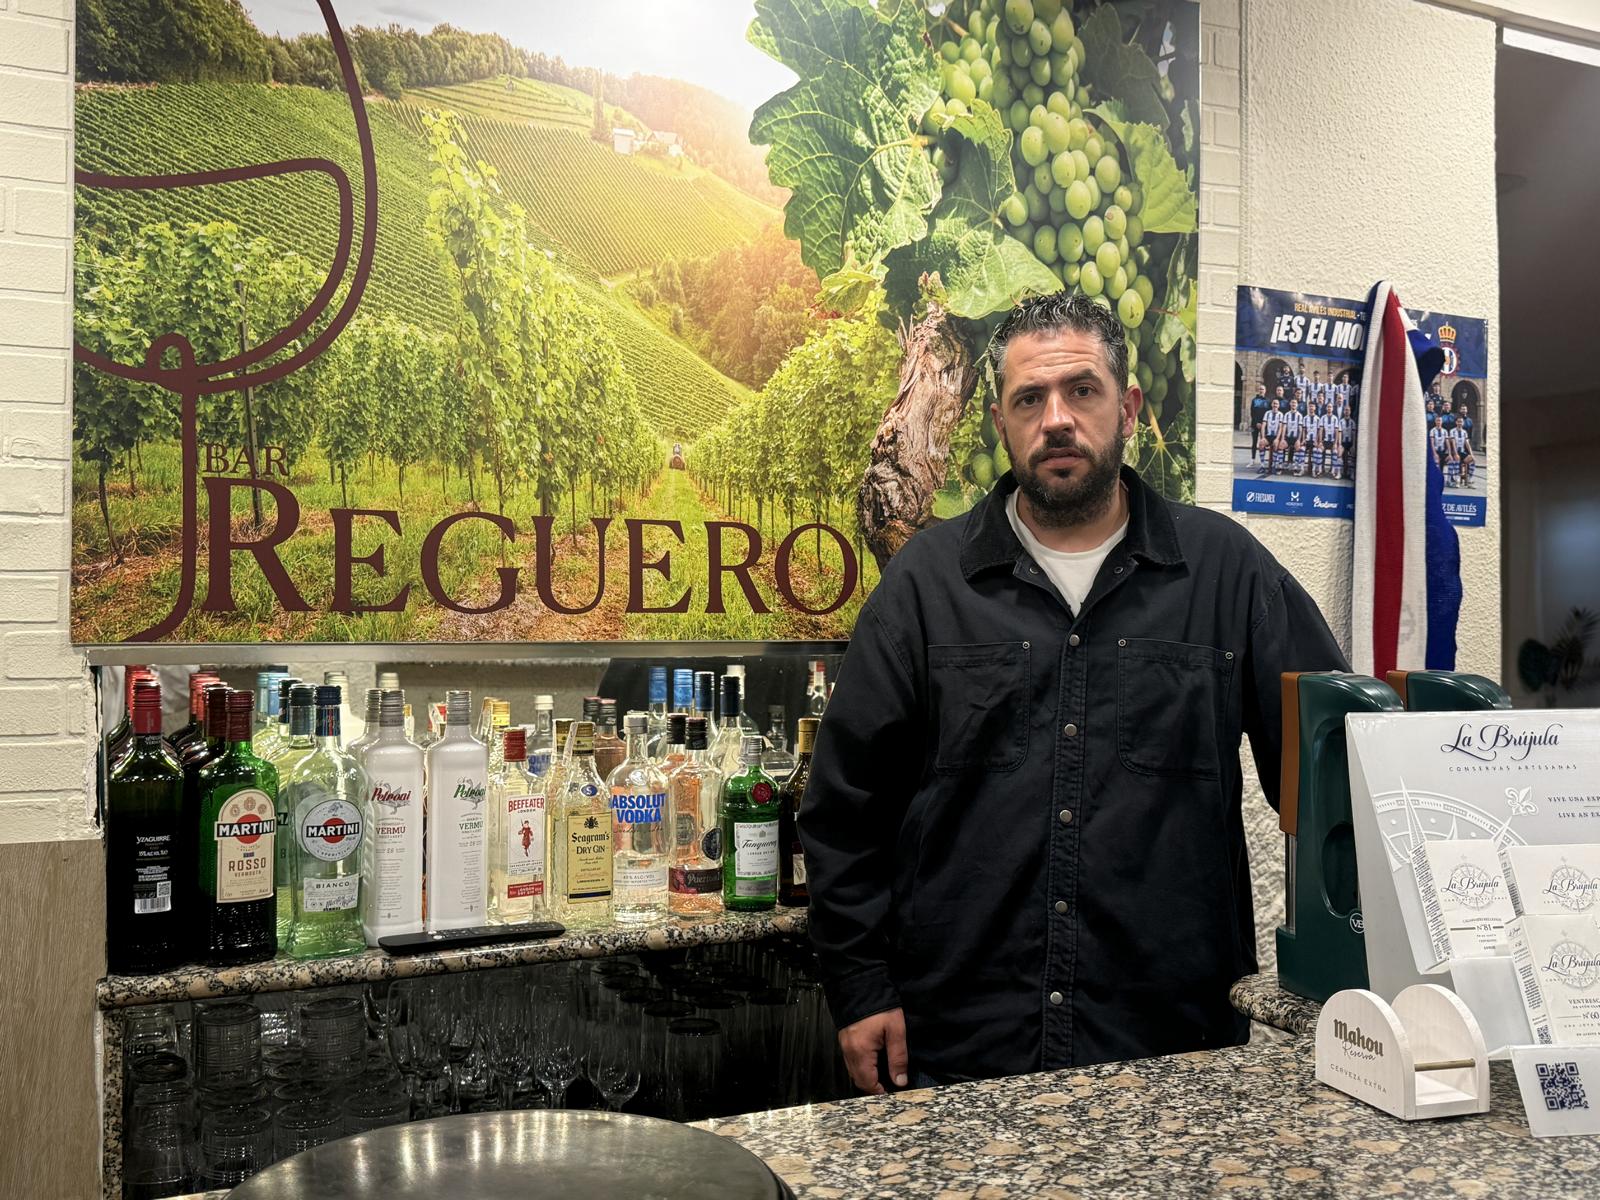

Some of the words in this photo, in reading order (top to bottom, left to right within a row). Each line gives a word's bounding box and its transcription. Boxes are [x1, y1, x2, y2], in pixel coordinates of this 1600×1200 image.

[1327, 307, 1357, 320] INDUSTRIAL
[1270, 314, 1306, 344] ¡ES
[1305, 318, 1329, 346] EL
[1330, 320, 1366, 350] MO
[204, 442, 288, 476] BAR
[202, 476, 859, 617] REGUERO
[1441, 723, 1497, 761] La
[1477, 723, 1564, 761] Brújula
[508, 797, 545, 813] BEEFEATER
[611, 793, 666, 809] ABSOLUT
[616, 808, 662, 824] VODKA
[218, 820, 274, 836] MARTINI
[308, 823, 358, 837] MARTINI
[375, 826, 406, 835] VERMU
[571, 831, 610, 845] Seagram's
[576, 845, 593, 855] DRY
[593, 844, 606, 854] GIN
[228, 857, 267, 872] ROSSO
[315, 881, 350, 889] BIANCO
[1441, 877, 1468, 897] La
[1543, 879, 1570, 900] La
[1541, 954, 1568, 976] La
[1333, 1018, 1384, 1057] Mahou
[1342, 1040, 1377, 1062] Reserva
[1330, 1063, 1361, 1081] CERVEZA
[1364, 1078, 1387, 1094] EXTRA
